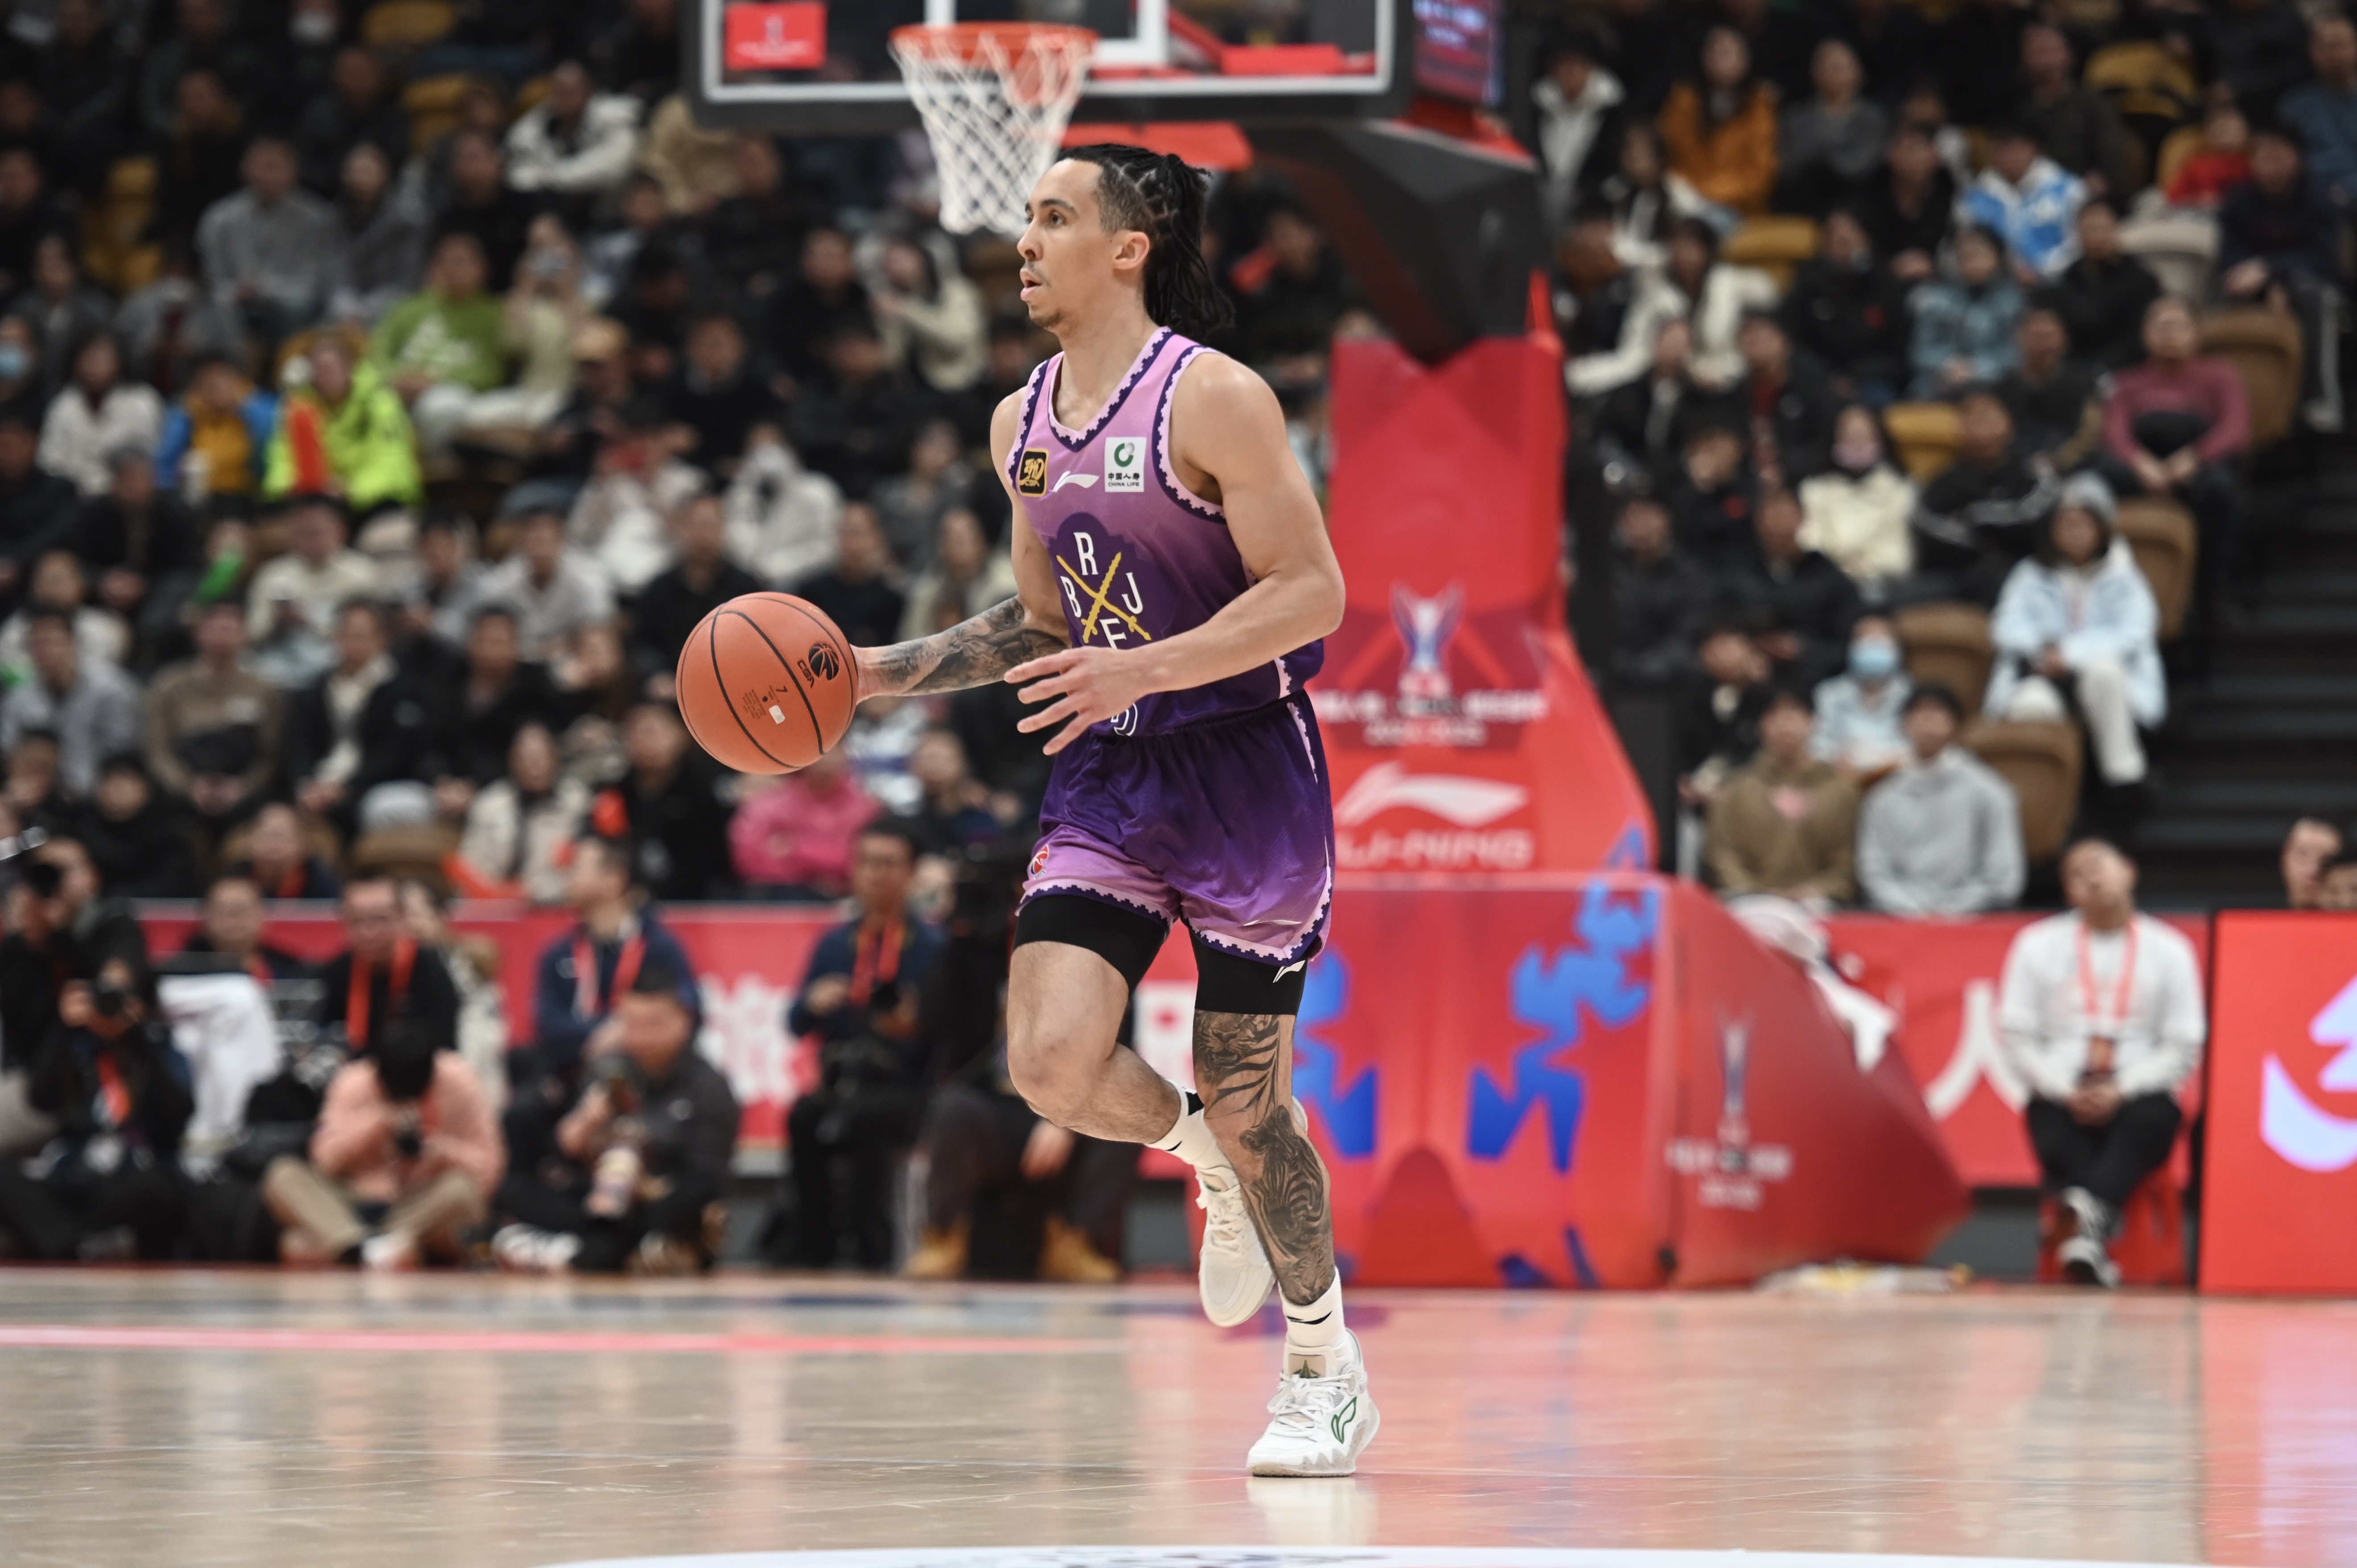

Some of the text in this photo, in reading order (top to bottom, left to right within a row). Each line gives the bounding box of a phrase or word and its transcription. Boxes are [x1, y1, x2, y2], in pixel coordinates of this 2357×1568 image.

[1073, 532, 1098, 576] R
[1060, 572, 1143, 618] B J
